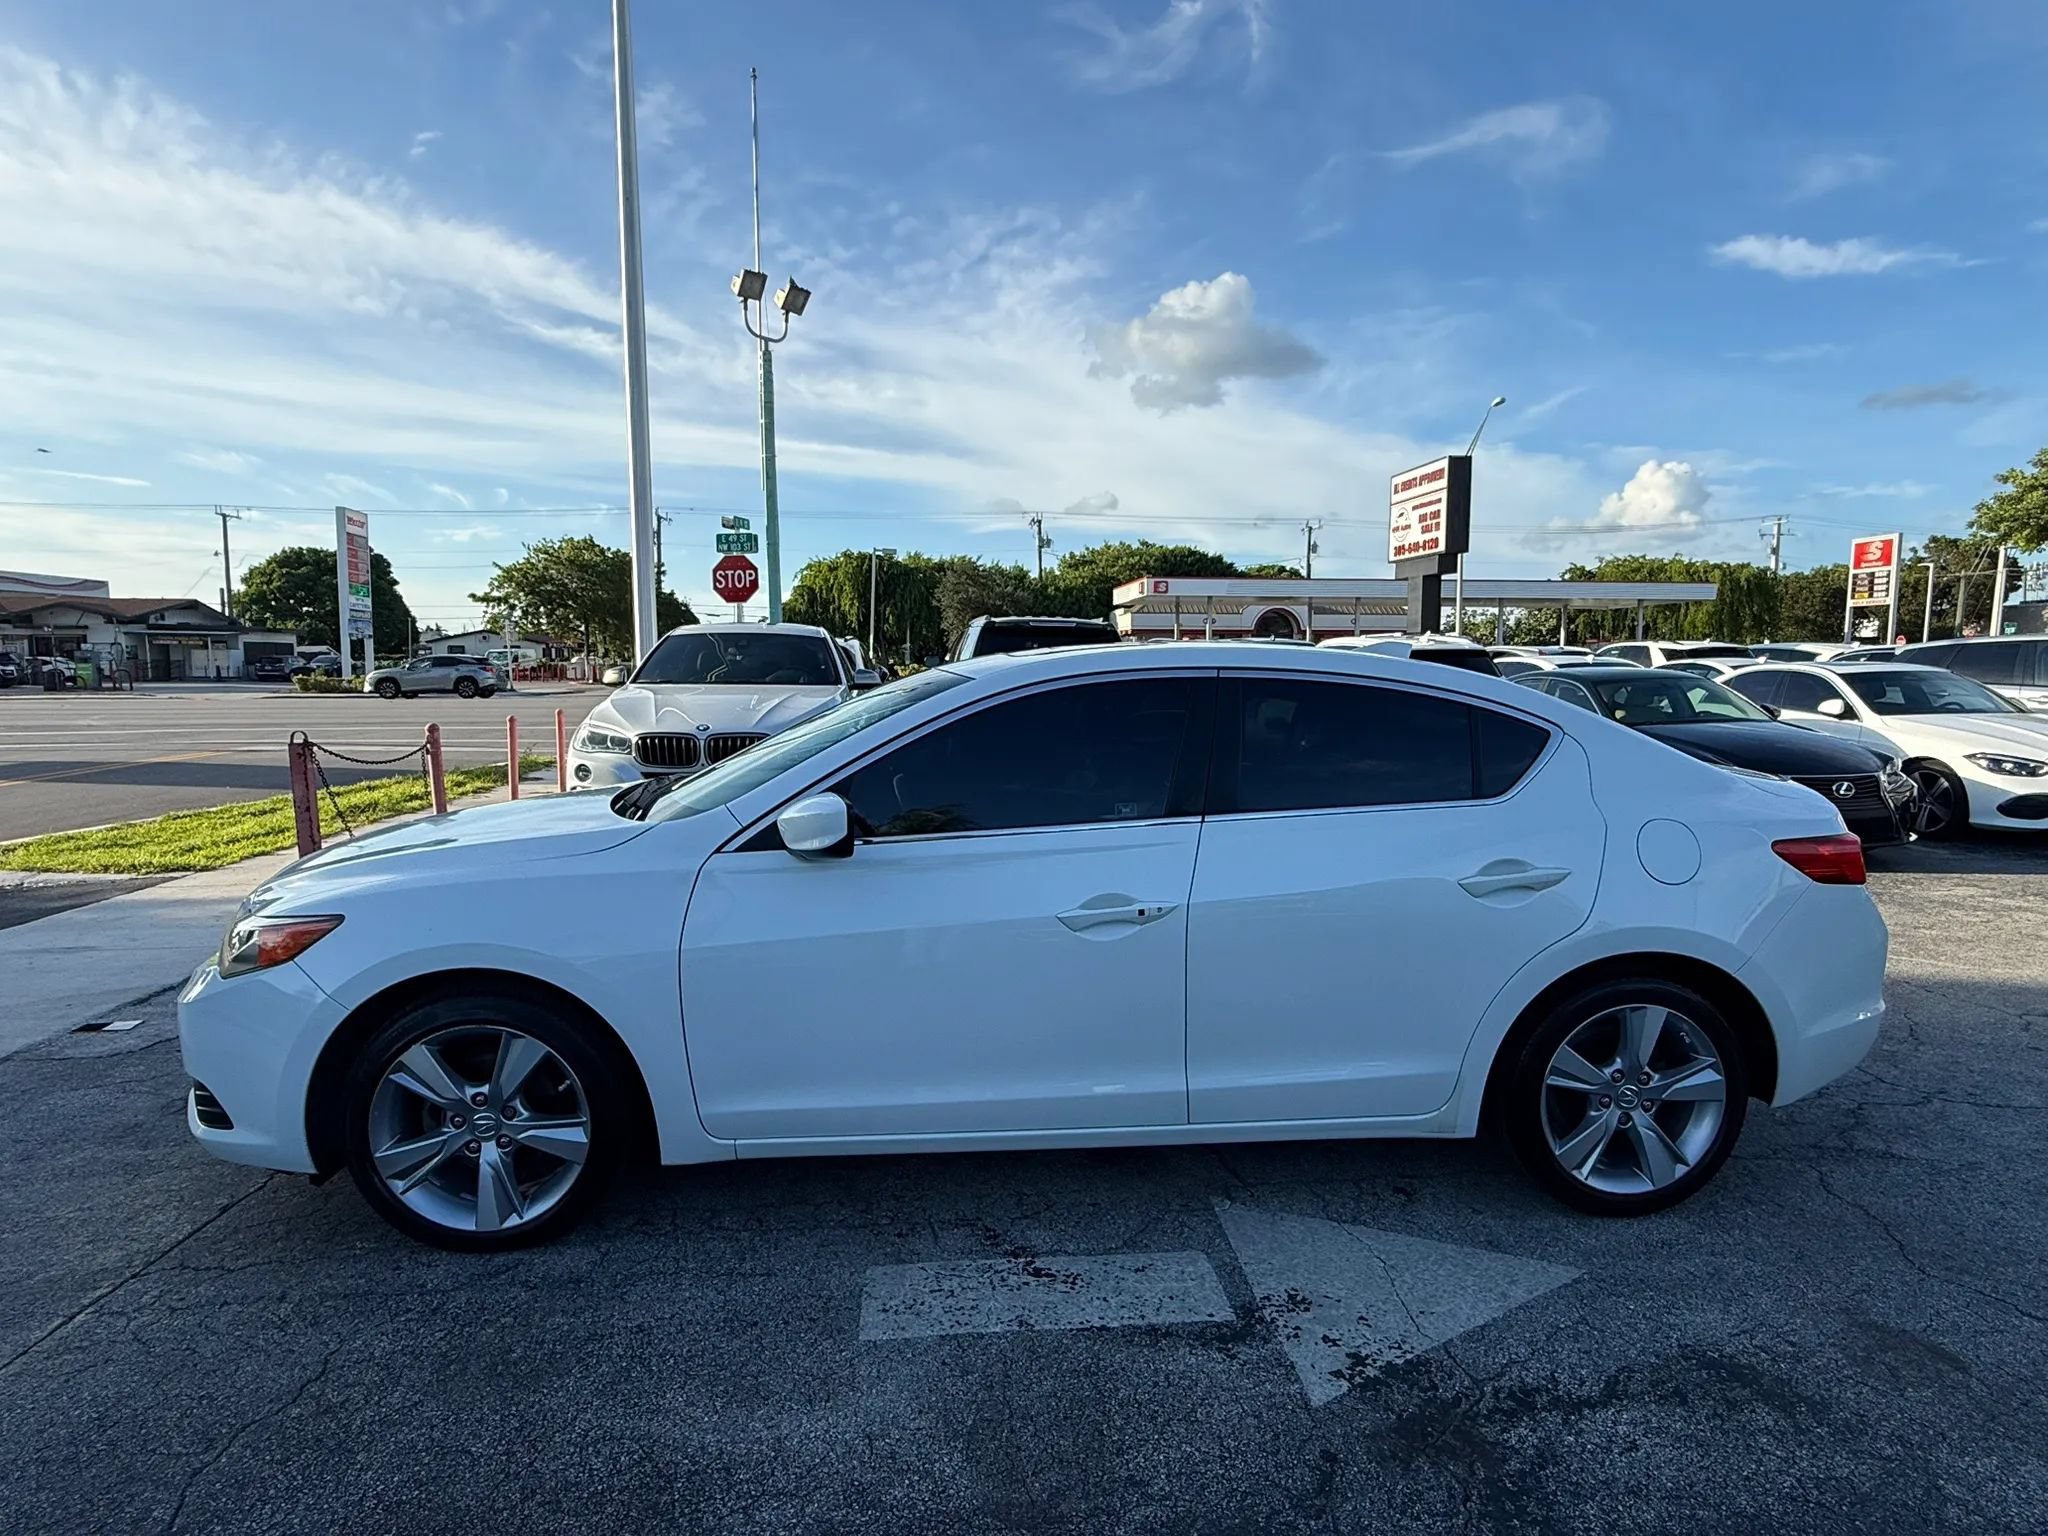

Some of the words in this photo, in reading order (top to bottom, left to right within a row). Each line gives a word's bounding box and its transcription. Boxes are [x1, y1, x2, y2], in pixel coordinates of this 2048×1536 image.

[722, 535, 727, 543] E
[729, 535, 738, 543] 49
[739, 535, 747, 543] ST
[730, 543, 741, 551] 103
[715, 570, 756, 588] STOP
